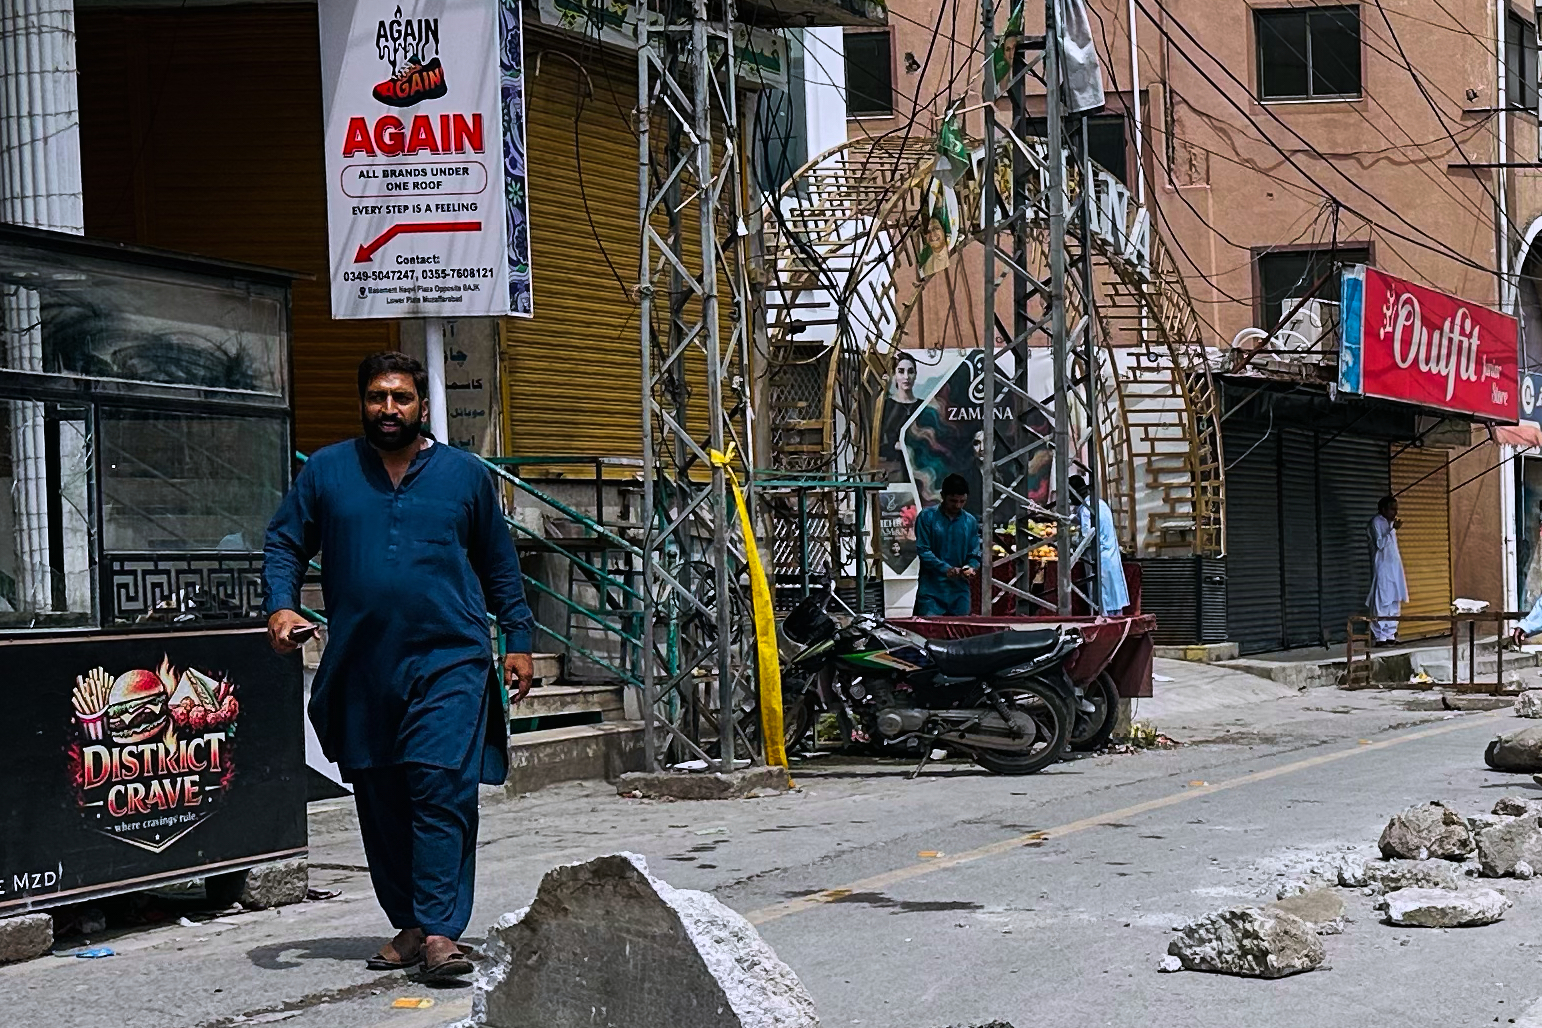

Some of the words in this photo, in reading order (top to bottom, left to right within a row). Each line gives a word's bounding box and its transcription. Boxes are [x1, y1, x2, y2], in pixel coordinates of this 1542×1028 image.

[375, 18, 439, 54] AGAIN
[377, 67, 442, 99] AGAIN
[342, 113, 486, 157] AGAIN
[358, 169, 379, 179] ALL
[382, 167, 428, 178] BRANDS
[430, 166, 470, 176] UNDER
[386, 181, 409, 191] ONE
[412, 180, 443, 191] ROOF
[352, 204, 383, 215] EVERY
[385, 204, 410, 215] STEP
[412, 203, 421, 214] IS
[424, 203, 432, 214] A
[435, 202, 478, 213] FEELING
[396, 253, 441, 266] Contact:
[421, 267, 494, 280] 0355-7608121
[1393, 292, 1481, 402] Outfit
[947, 406, 1014, 420] ZAMNA
[82, 732, 226, 790] DISTRICT
[107, 775, 203, 818] CRAVE
[114, 821, 141, 832] where
